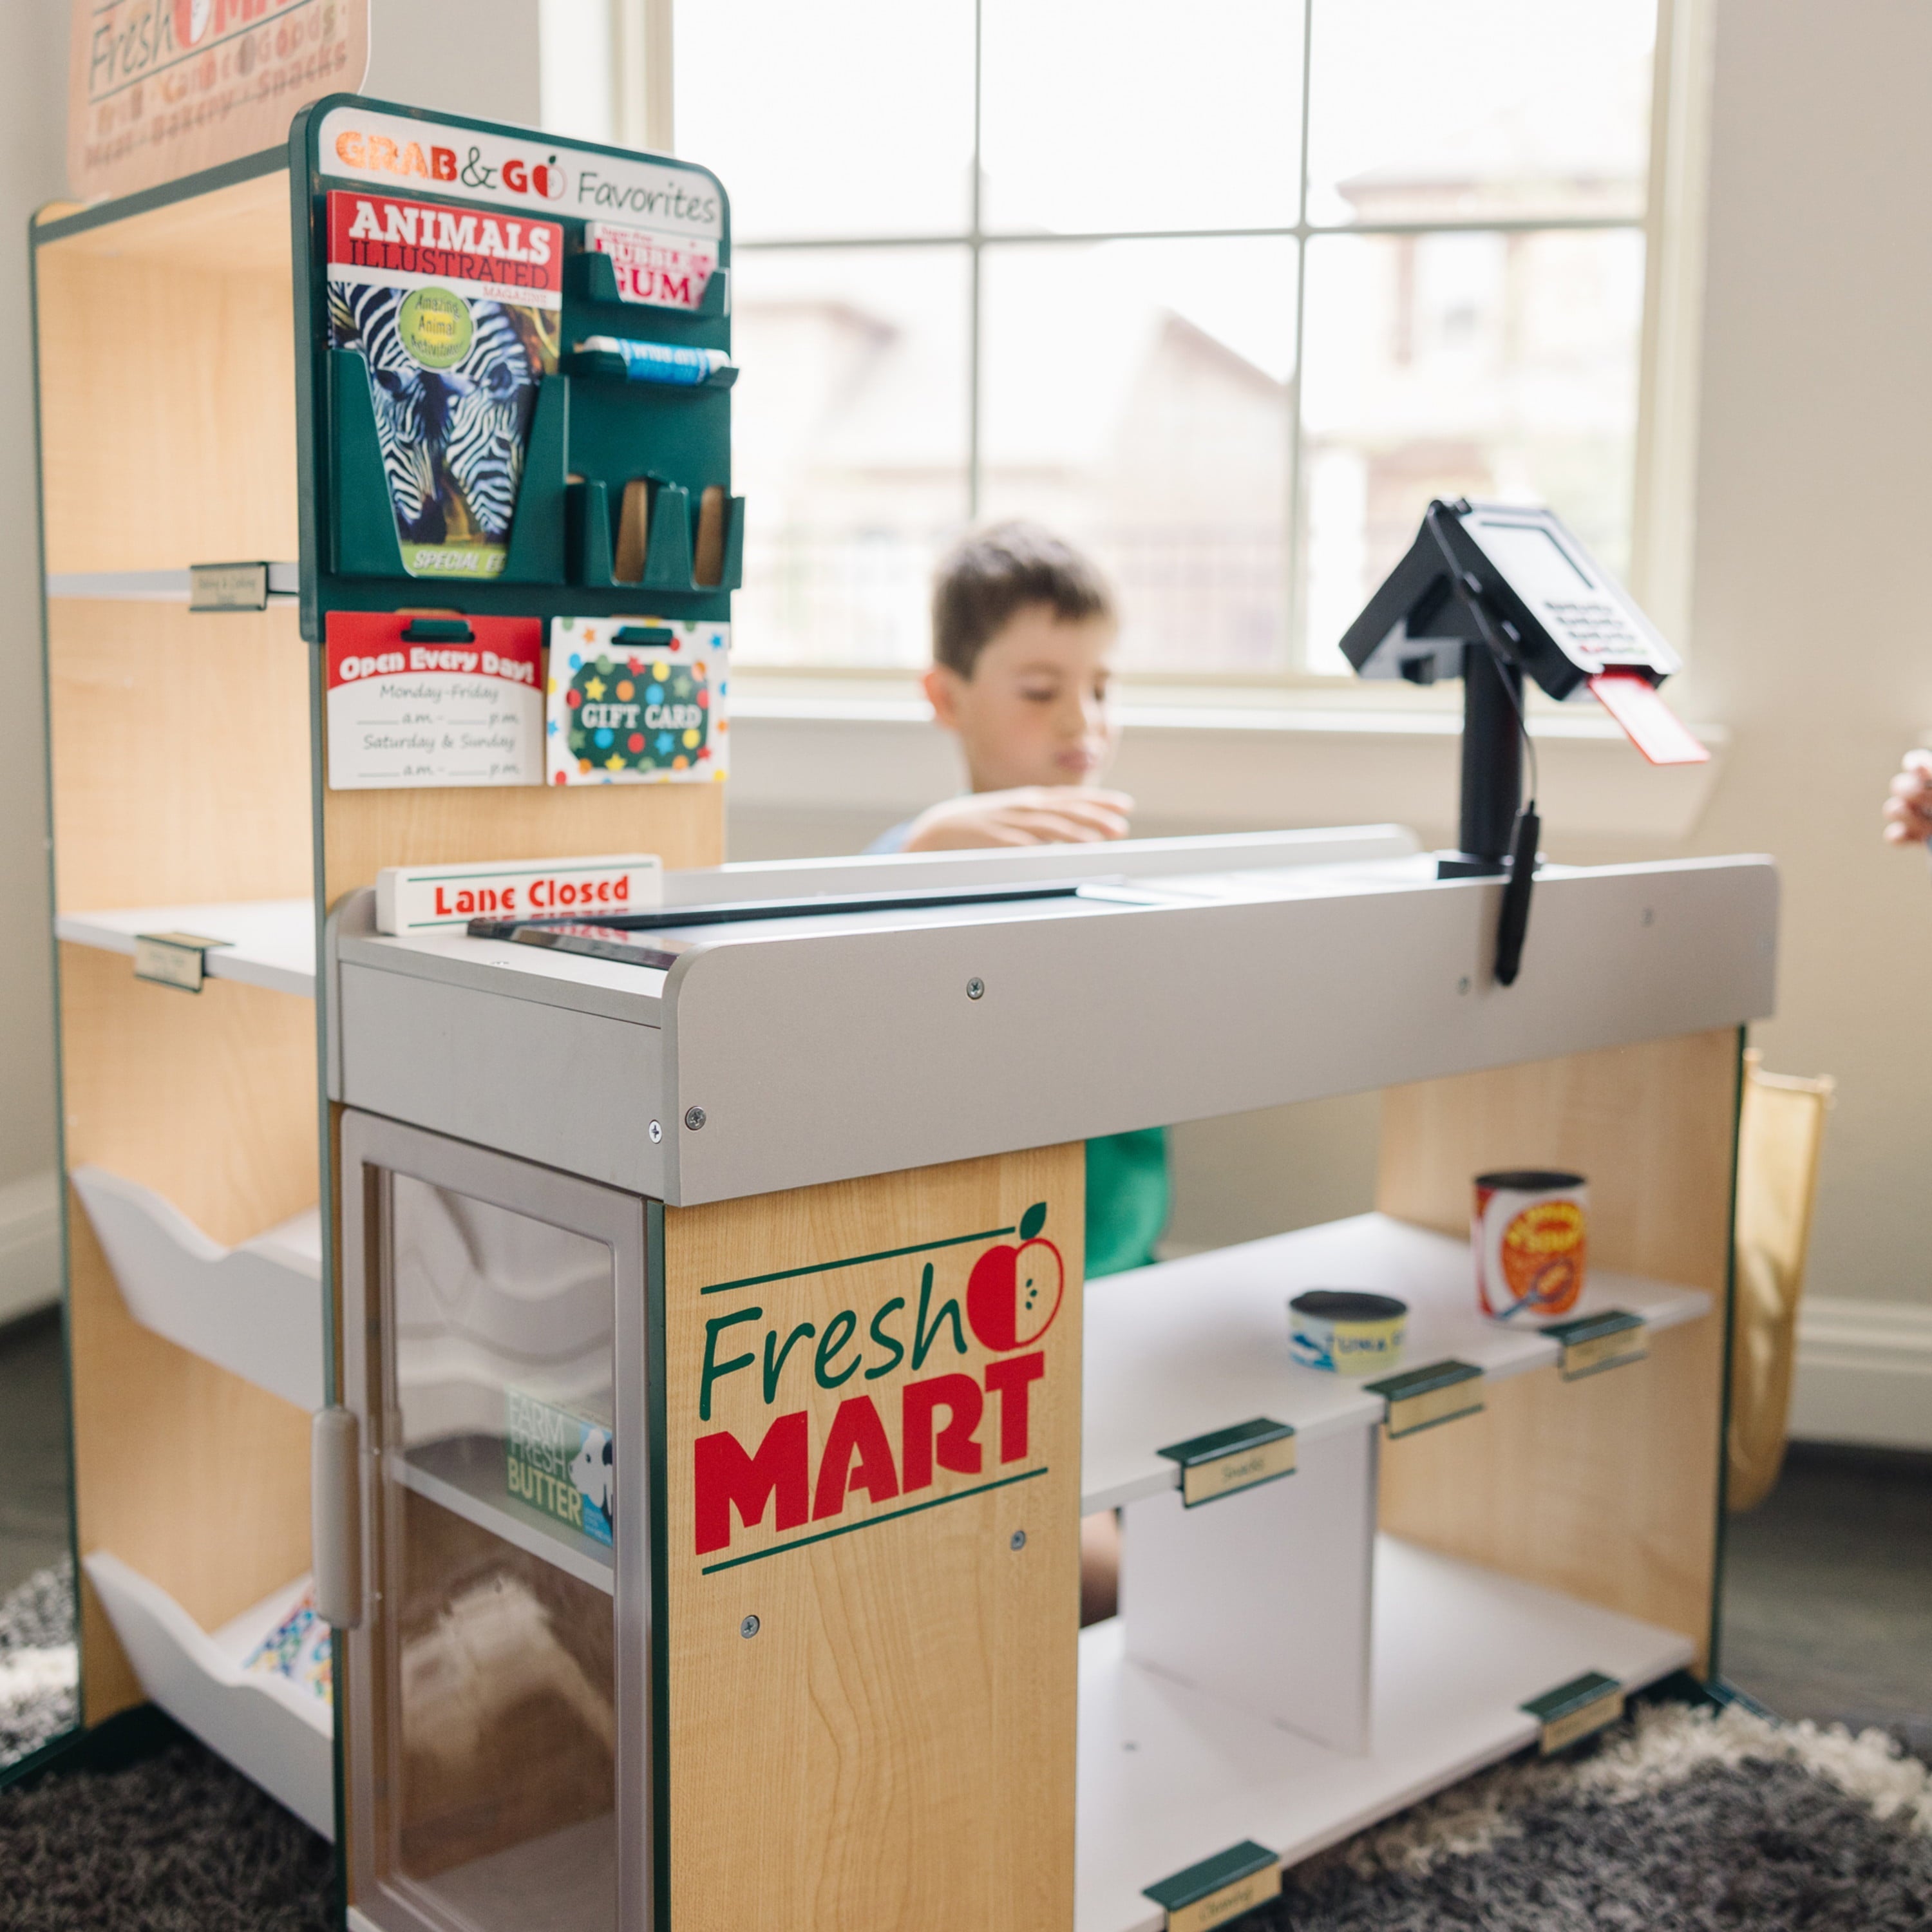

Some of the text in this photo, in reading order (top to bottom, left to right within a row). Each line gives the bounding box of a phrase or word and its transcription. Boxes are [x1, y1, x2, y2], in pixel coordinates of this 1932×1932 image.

[578, 171, 717, 225] Favorites
[348, 201, 552, 265] ANIMALS
[350, 240, 551, 290] ILLUSTRATED
[415, 294, 461, 321] Amazing
[483, 287, 547, 306] MAGAZINE
[419, 315, 455, 336] Animal
[413, 549, 480, 572] SPECIAL
[339, 646, 535, 683] Open Every Day!
[581, 704, 703, 730] GIFT CARD
[363, 734, 515, 753] Saturday & Sunday
[435, 875, 629, 915] Lane Closed
[699, 1262, 967, 1421] Fresh
[509, 1389, 565, 1448] FARM
[511, 1426, 567, 1481] FRESH
[694, 1350, 1045, 1556] MART
[507, 1457, 583, 1527] BUTTER
